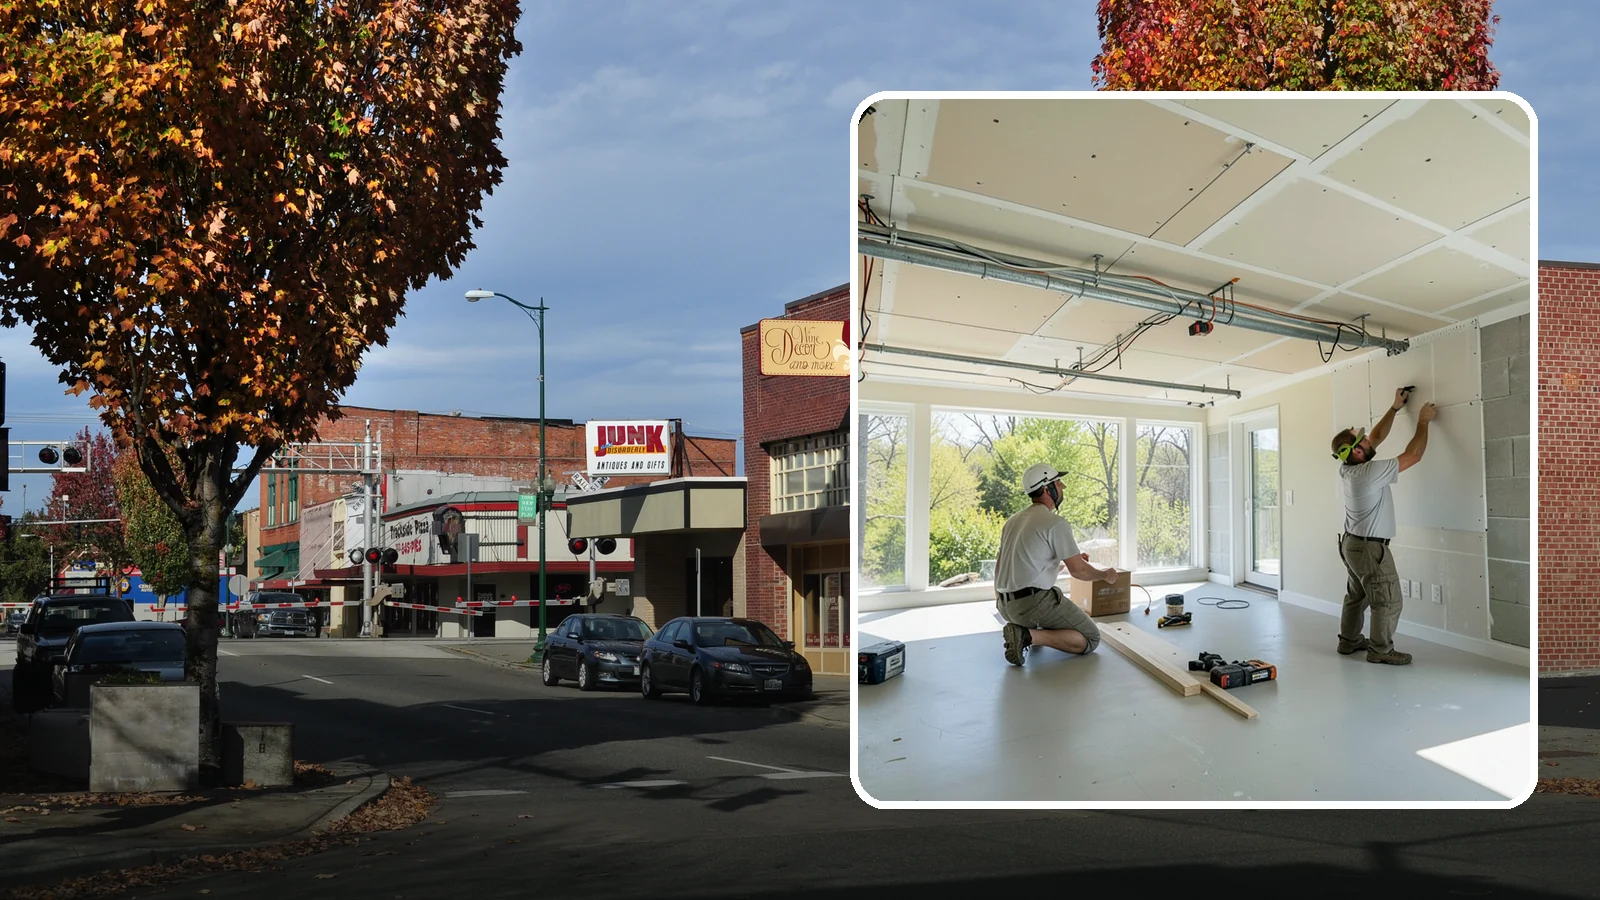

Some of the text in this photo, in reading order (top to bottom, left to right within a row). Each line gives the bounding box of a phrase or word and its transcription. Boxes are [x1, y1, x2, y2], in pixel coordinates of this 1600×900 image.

[595, 425, 664, 457] JUNK
[607, 446, 646, 454] DISORDERLY
[597, 460, 665, 470] ANTIQUES AND GIFTS
[415, 520, 429, 534] Pizza
